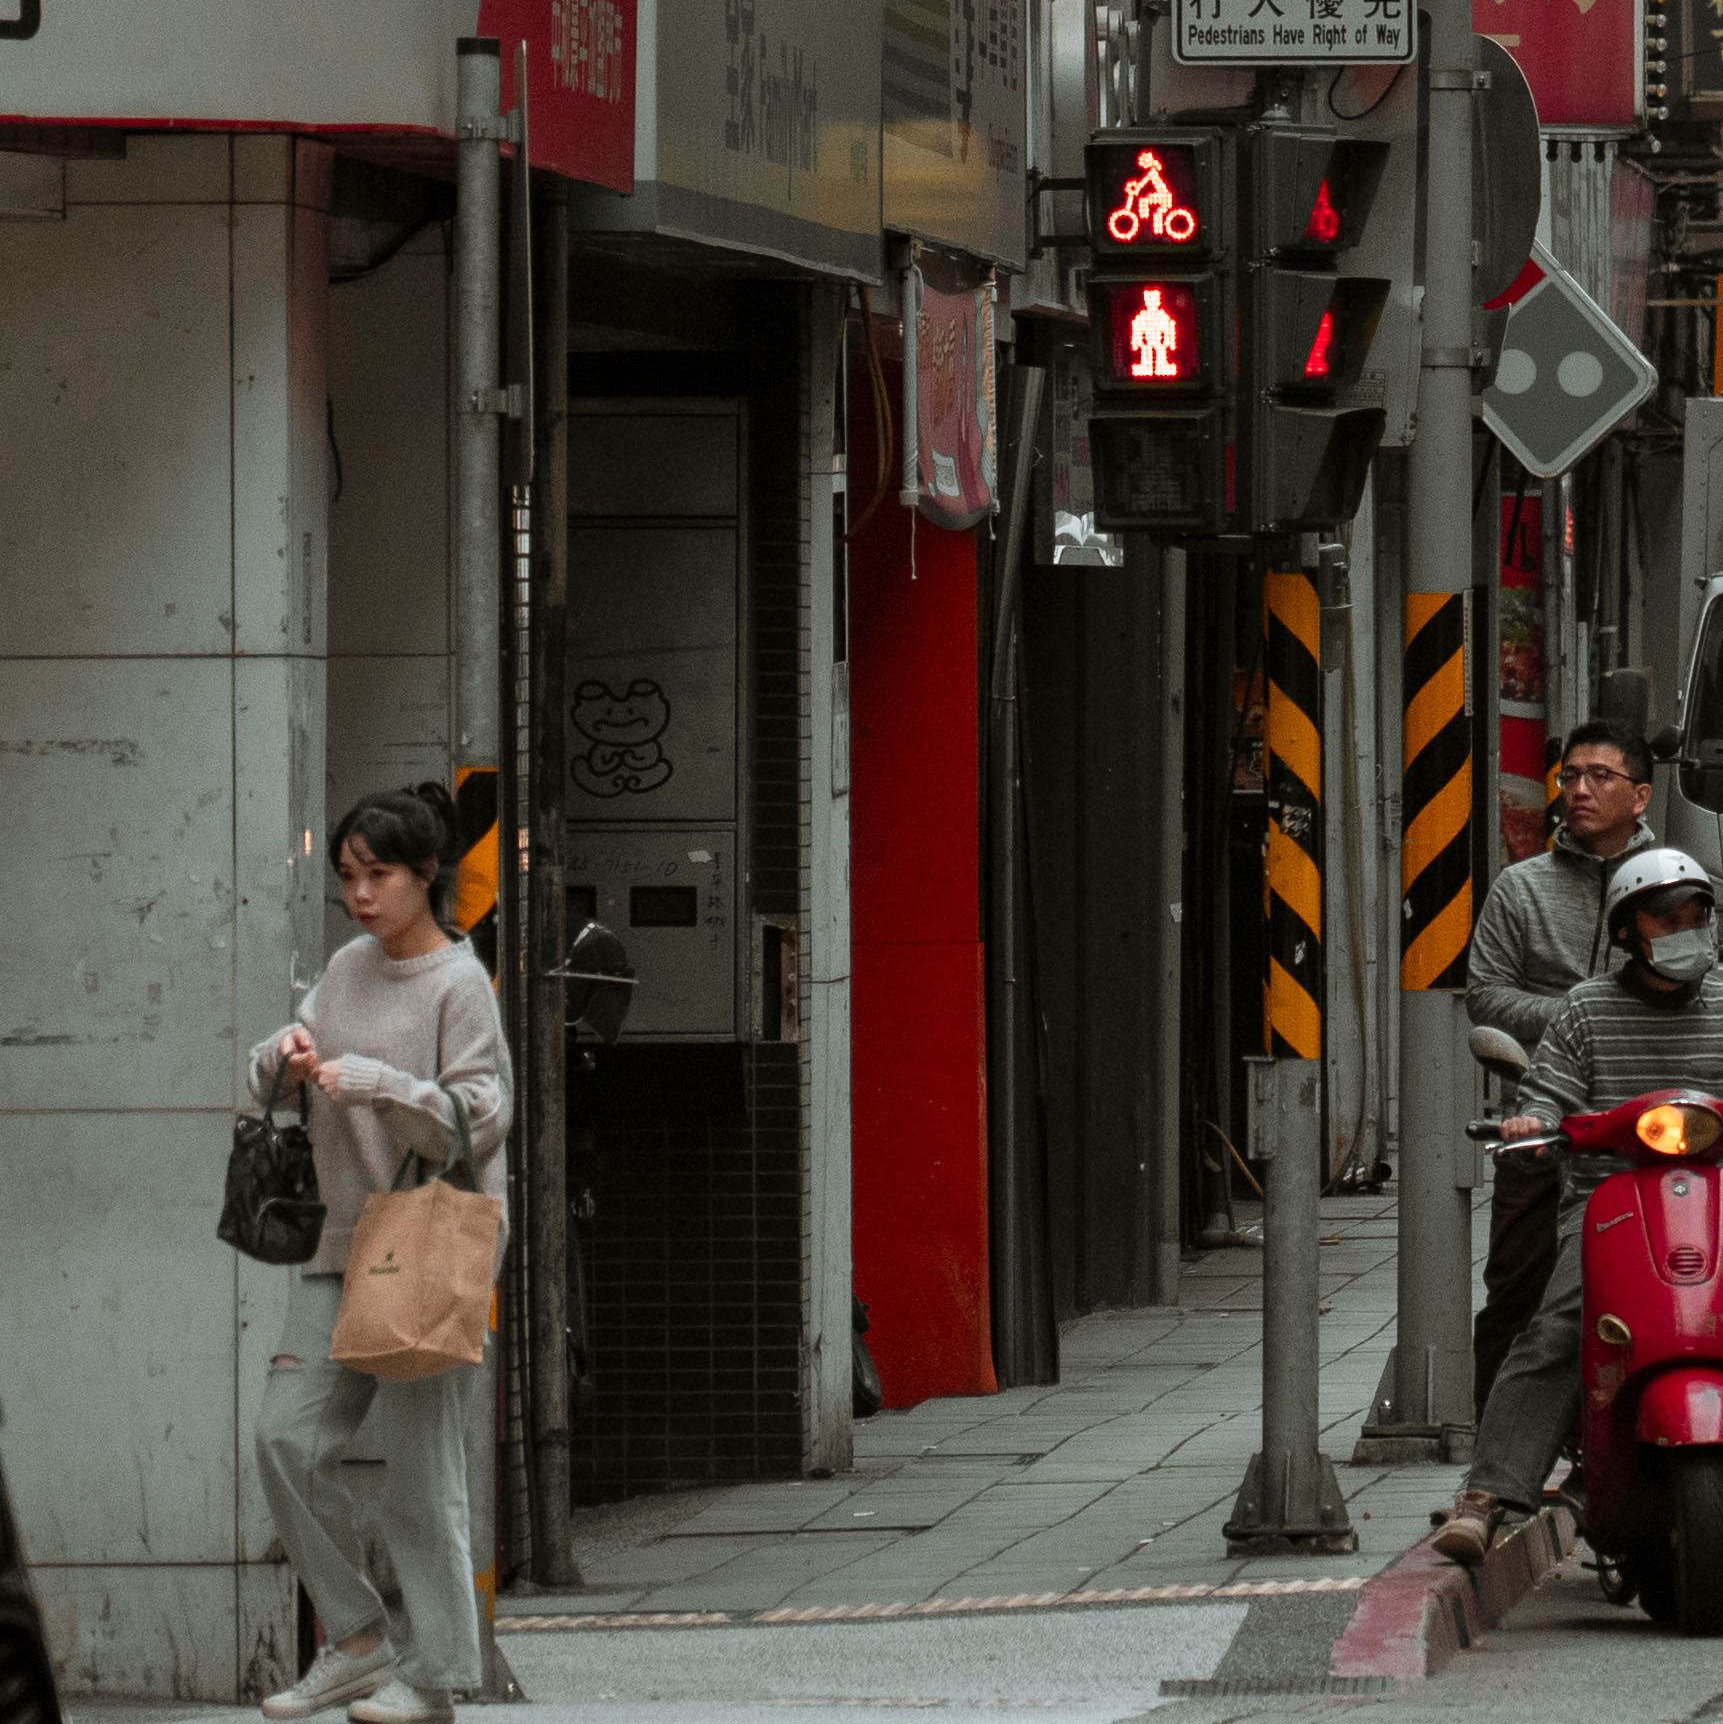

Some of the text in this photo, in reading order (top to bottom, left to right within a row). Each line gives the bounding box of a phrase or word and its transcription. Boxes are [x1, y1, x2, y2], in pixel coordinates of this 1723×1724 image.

[1188, 24, 1400, 51] Pedestrians Have Right of Way
